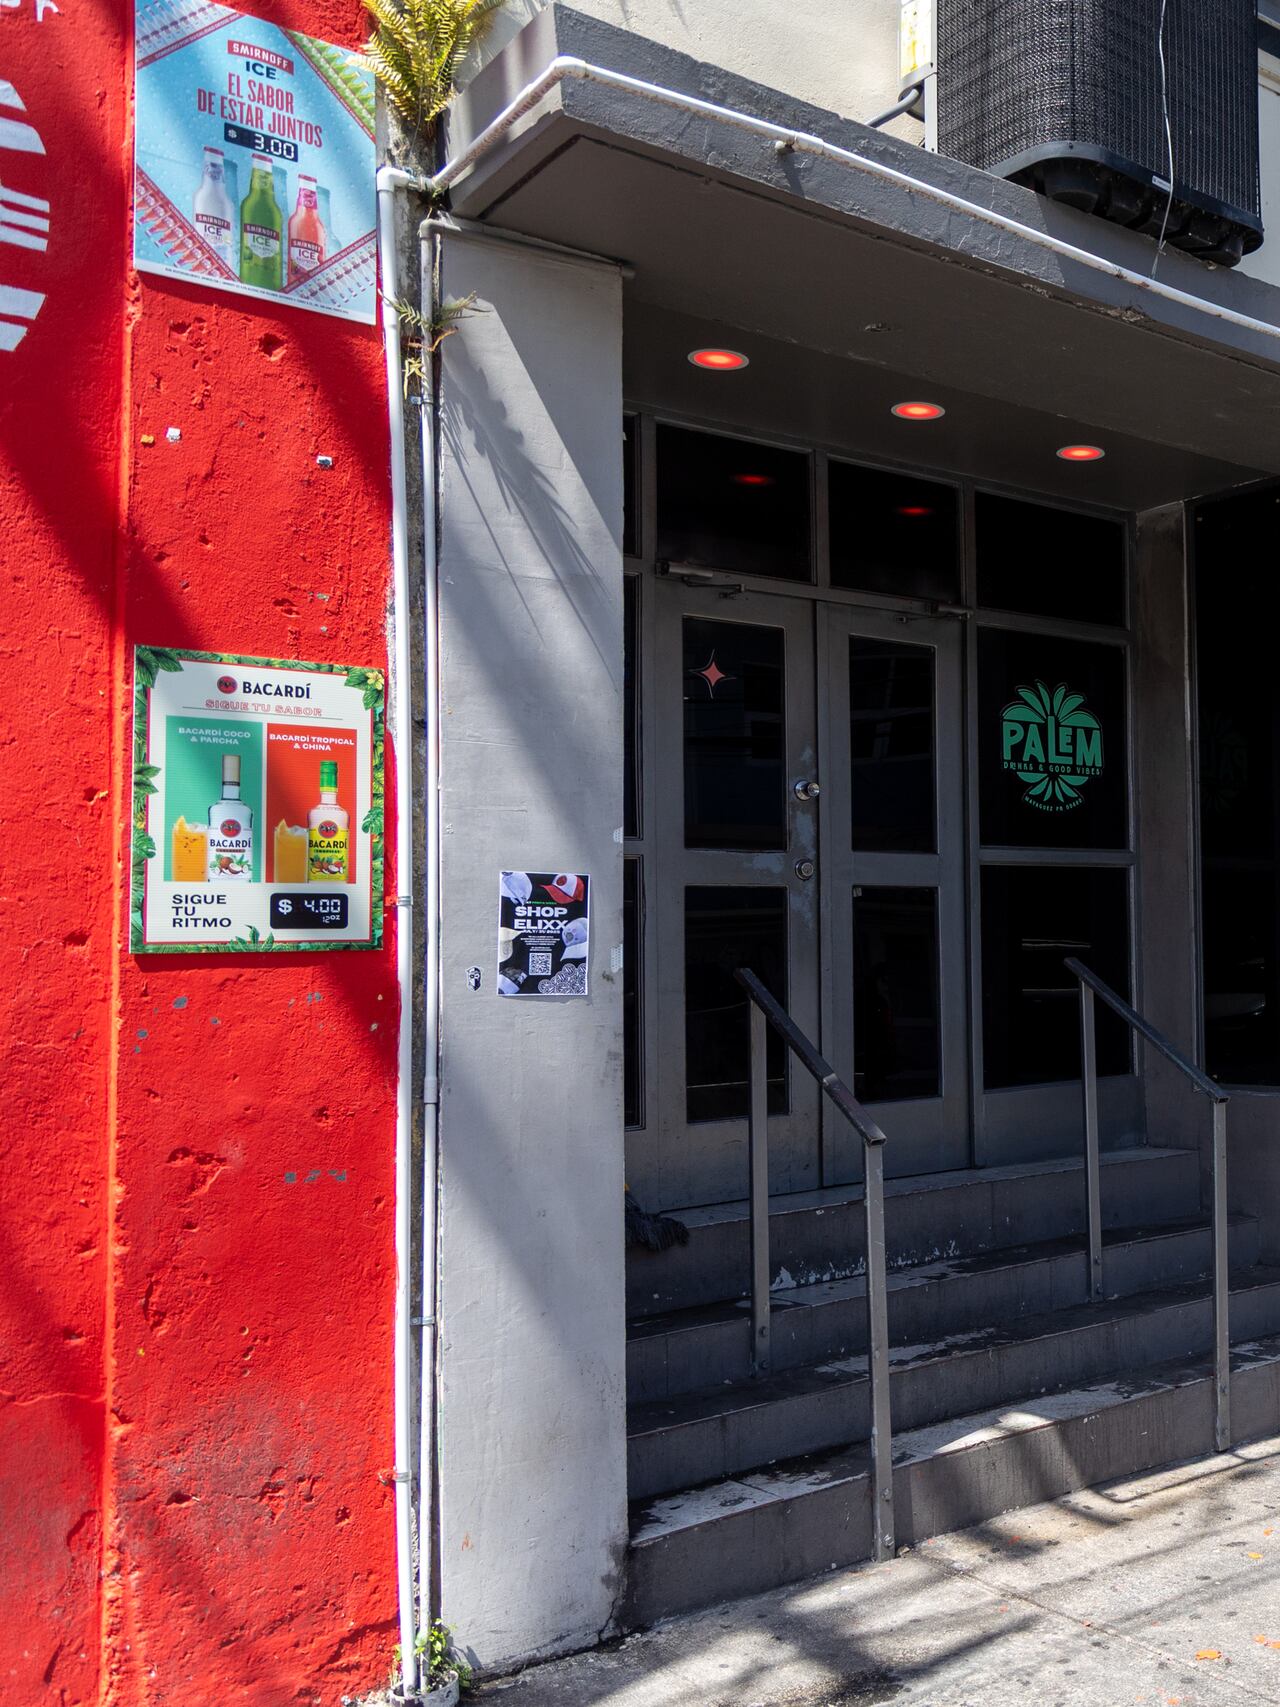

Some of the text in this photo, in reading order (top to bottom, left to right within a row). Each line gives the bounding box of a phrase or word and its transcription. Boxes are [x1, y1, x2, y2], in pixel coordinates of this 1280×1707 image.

[233, 43, 288, 69] SMIRNOFF
[246, 61, 276, 80] ICE
[228, 72, 294, 114] EL SABOR
[197, 88, 322, 148] DE ESTAR JUNTOS
[254, 133, 294, 159] 3.00
[204, 224, 222, 236] ICE
[253, 235, 271, 247] ICE
[299, 249, 317, 260] ICE
[242, 681, 311, 699] BACARDÍ
[205, 699, 322, 716] SIGUE TU SABOR
[178, 727, 251, 738] BACARDÍ COCO
[201, 736, 239, 745] PARCHA
[269, 733, 354, 746] BACARDÍ TROPICAL
[1002, 715, 1102, 767] PALEM
[302, 743, 331, 751] CHINA
[1049, 765, 1072, 773] GOOD
[1076, 767, 1100, 776] VIBES
[210, 838, 252, 848] BACARDÍ
[309, 839, 347, 849] BACARDÍ
[172, 894, 227, 905] SIGUE
[172, 906, 196, 916] TU
[278, 899, 341, 915] $ 4.00
[514, 906, 568, 917] SHOP
[172, 917, 232, 928] RITMO
[513, 919, 569, 930] ELIXX
